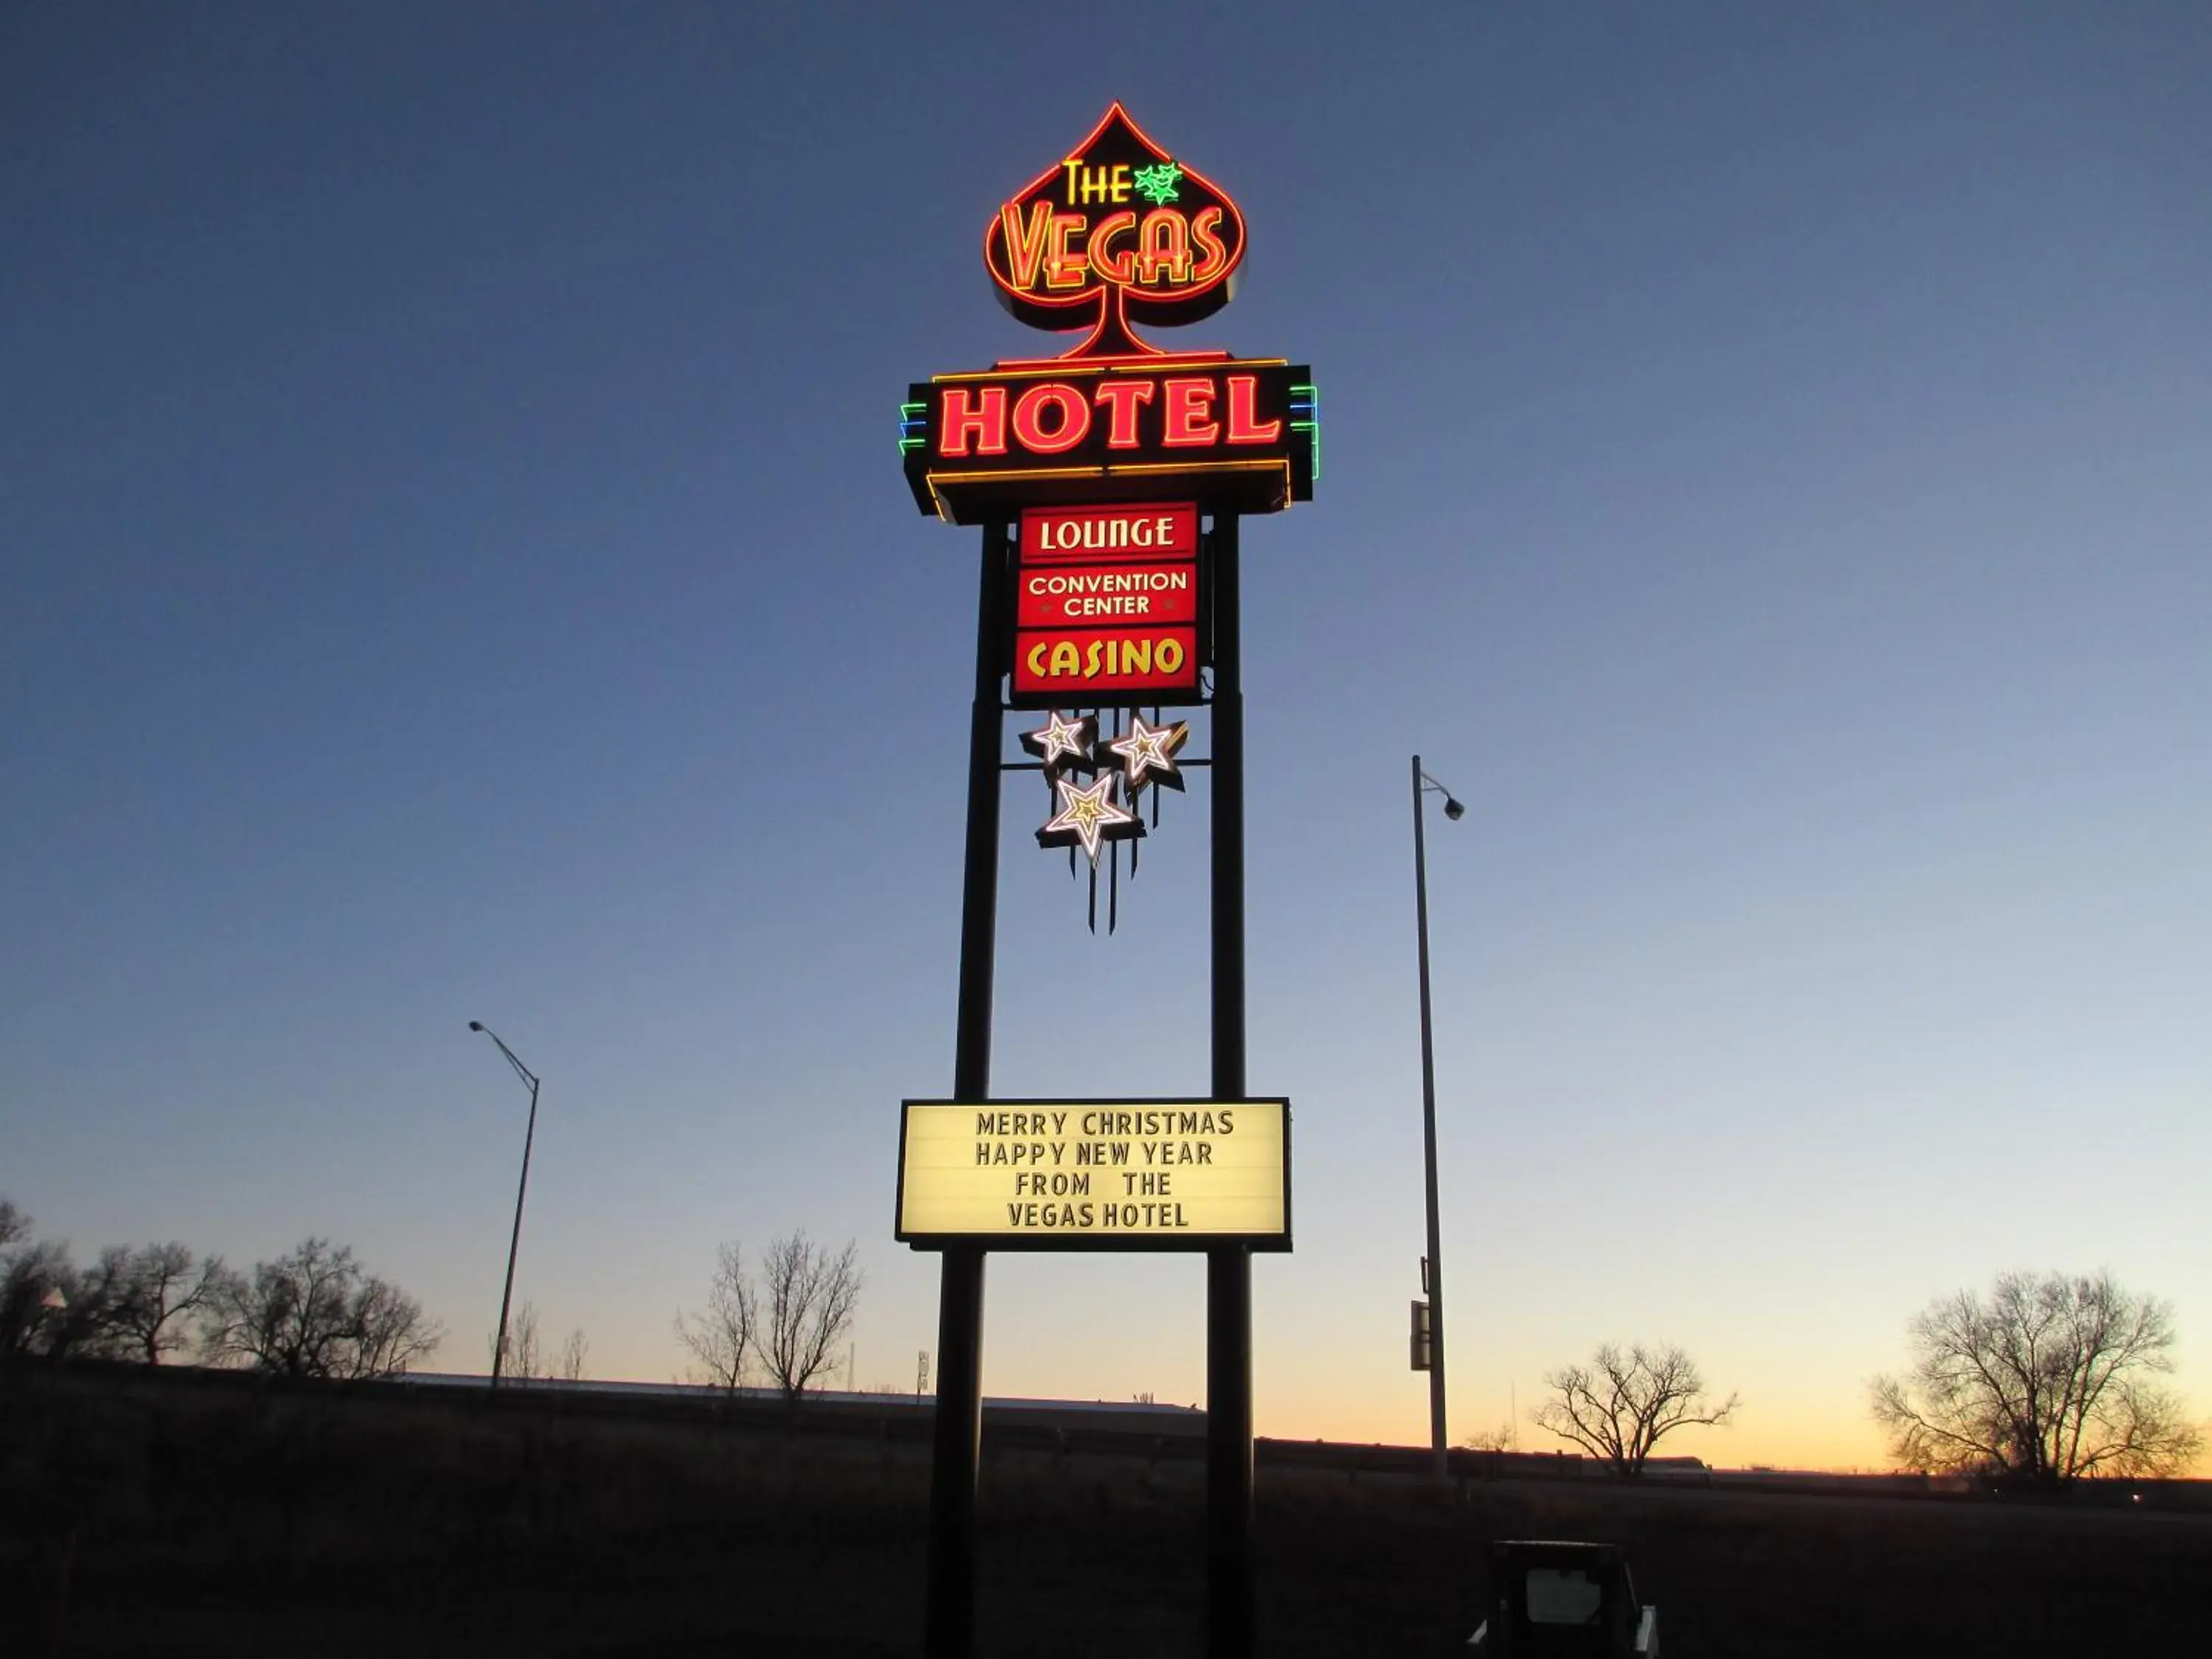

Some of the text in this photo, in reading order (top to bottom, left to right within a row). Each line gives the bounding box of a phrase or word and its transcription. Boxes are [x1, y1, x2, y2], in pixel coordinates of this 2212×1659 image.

[1062, 159, 1132, 205] THE
[1001, 200, 1227, 290] VEGAS
[939, 377, 1282, 456] HOTEL
[1040, 518, 1174, 550] LOUNGE
[1029, 571, 1187, 595] CONVENTION
[1064, 596, 1150, 616] CENTER
[1027, 637, 1184, 678] CASINO
[975, 1110, 1234, 1135] MERRY CHRISTMAS
[975, 1141, 1213, 1166] HAPPY NEW YEAR
[1015, 1172, 1171, 1196] FROM THE
[1007, 1203, 1189, 1227] VEGAS HOTEL
